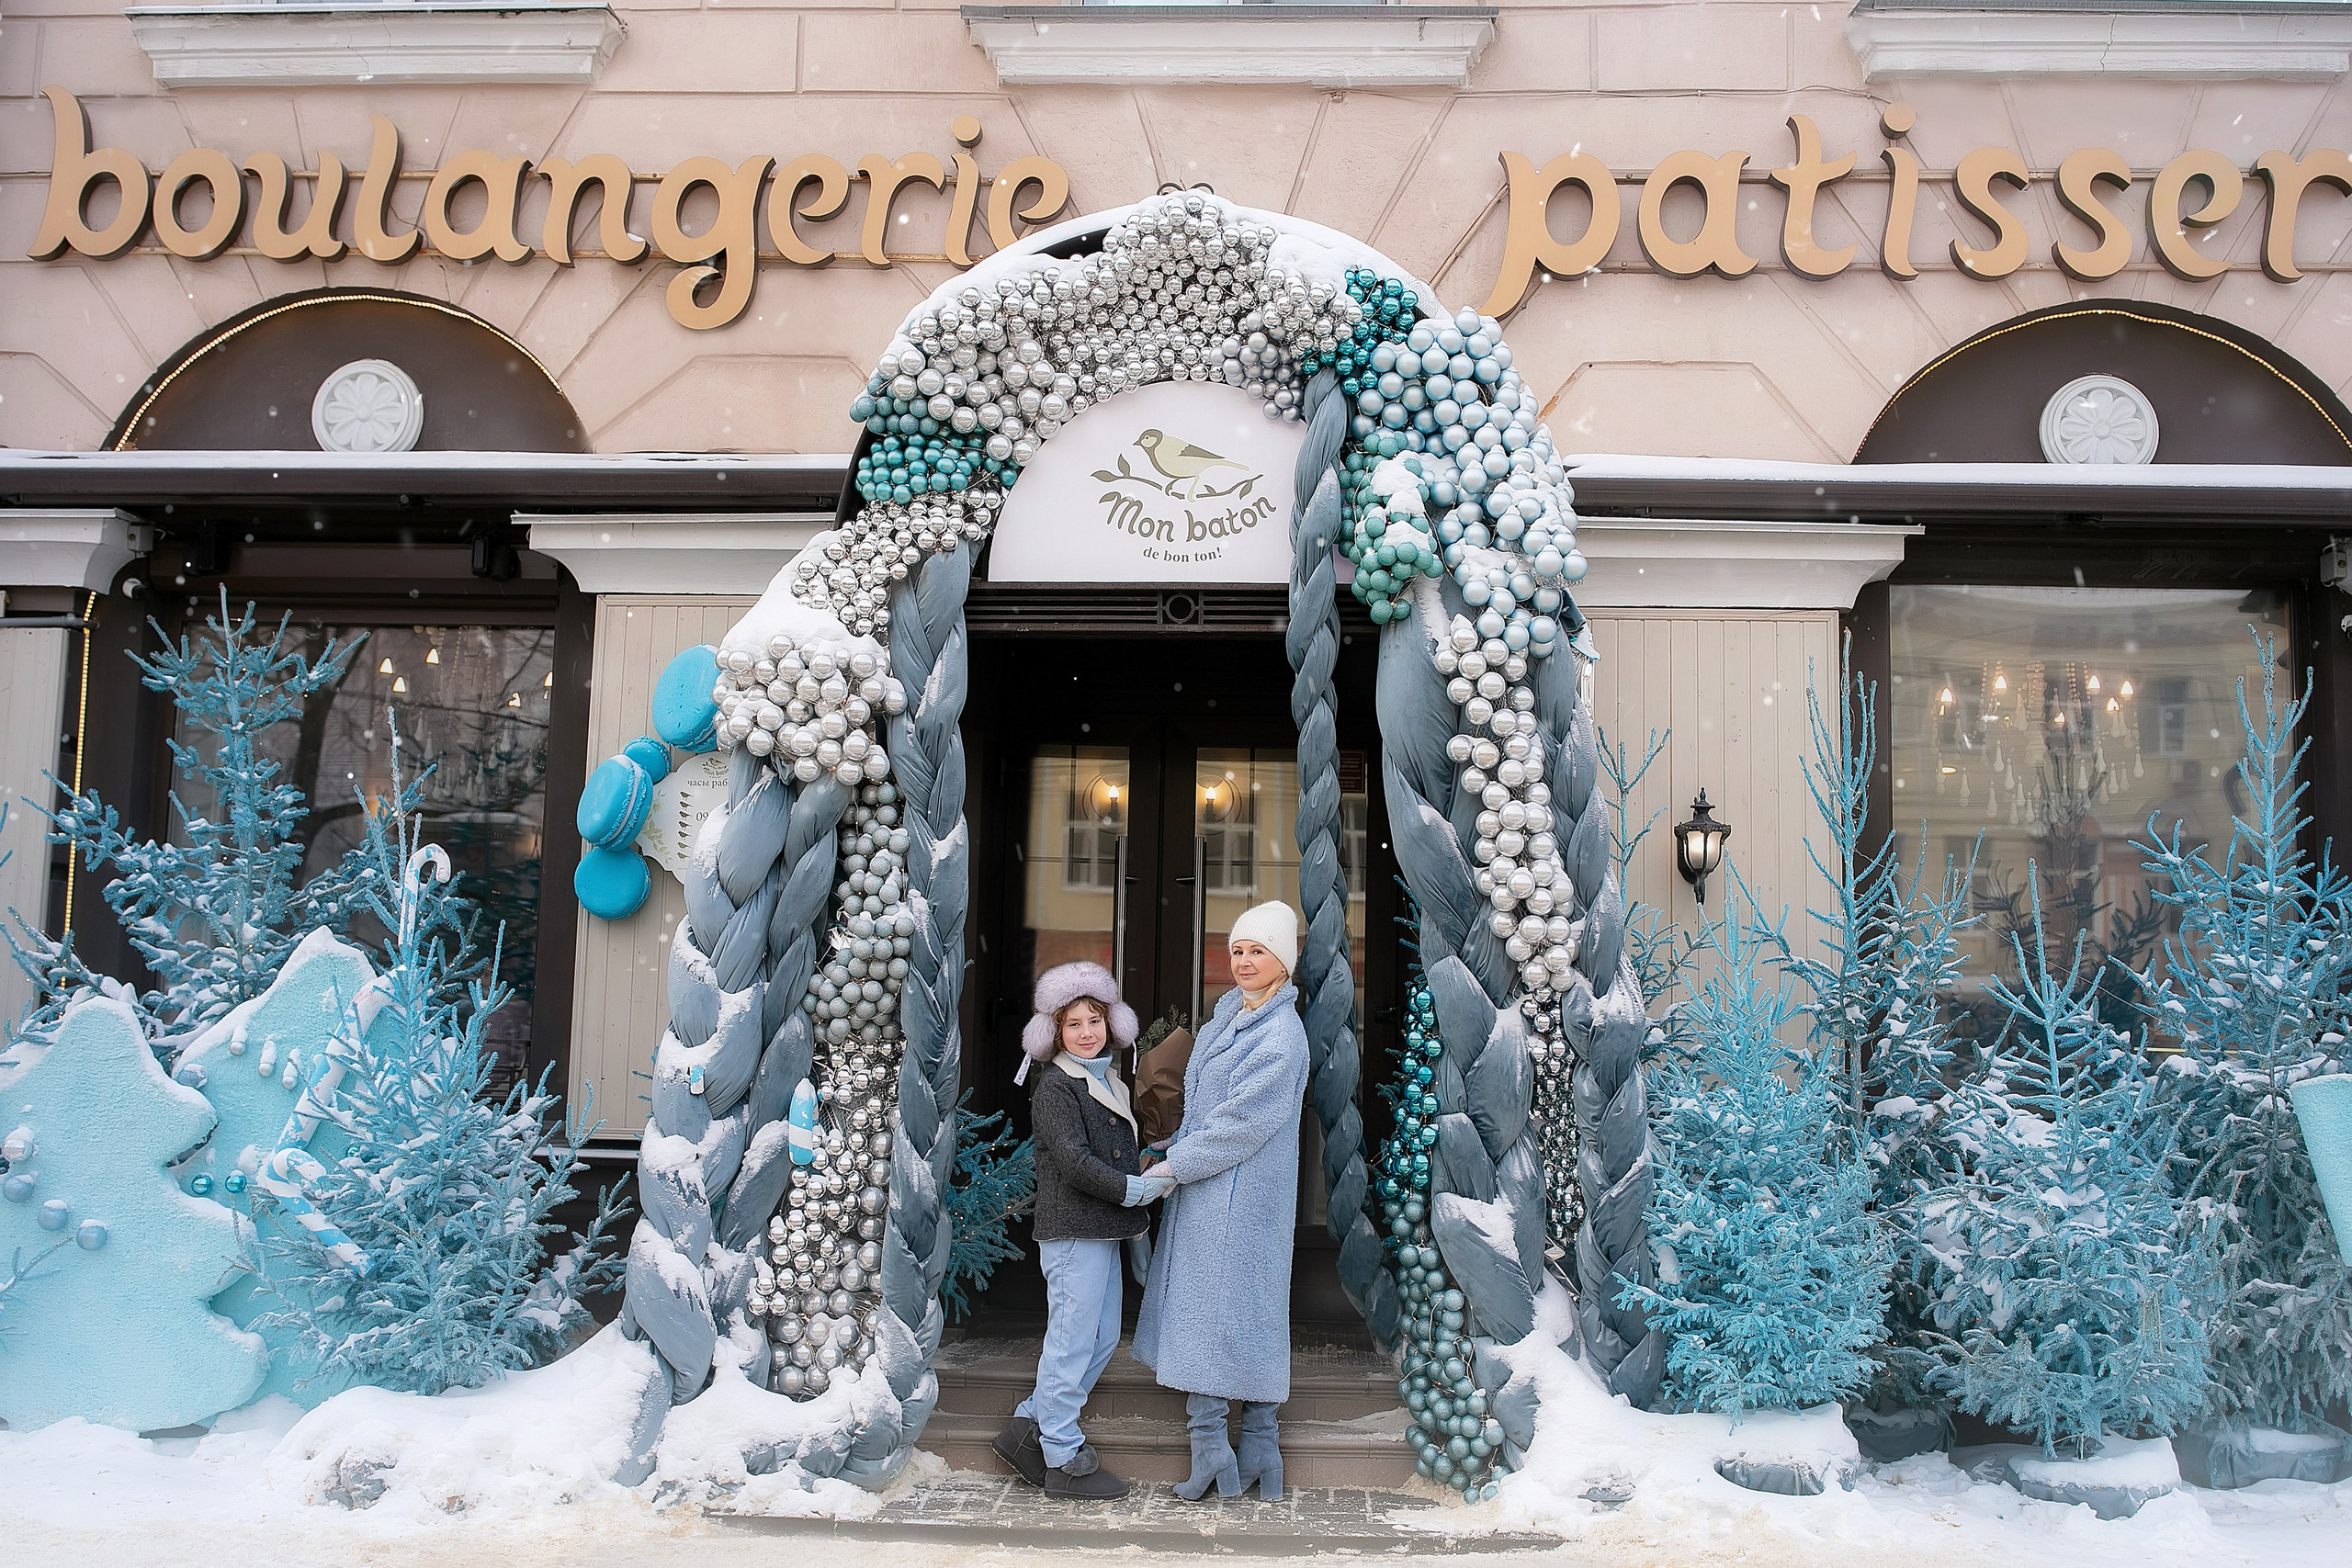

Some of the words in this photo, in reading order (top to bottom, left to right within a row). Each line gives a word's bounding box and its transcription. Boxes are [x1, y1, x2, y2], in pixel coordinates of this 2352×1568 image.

[26, 85, 1069, 331] boulangerie
[1479, 101, 2352, 318] patisser
[1099, 491, 1174, 543] Mon
[1184, 496, 1276, 542] baton
[1143, 547, 1159, 559] de
[1163, 550, 1190, 562] bon
[1194, 547, 1222, 562] ton!
[711, 778, 728, 788] раб
[695, 811, 709, 822] 09
